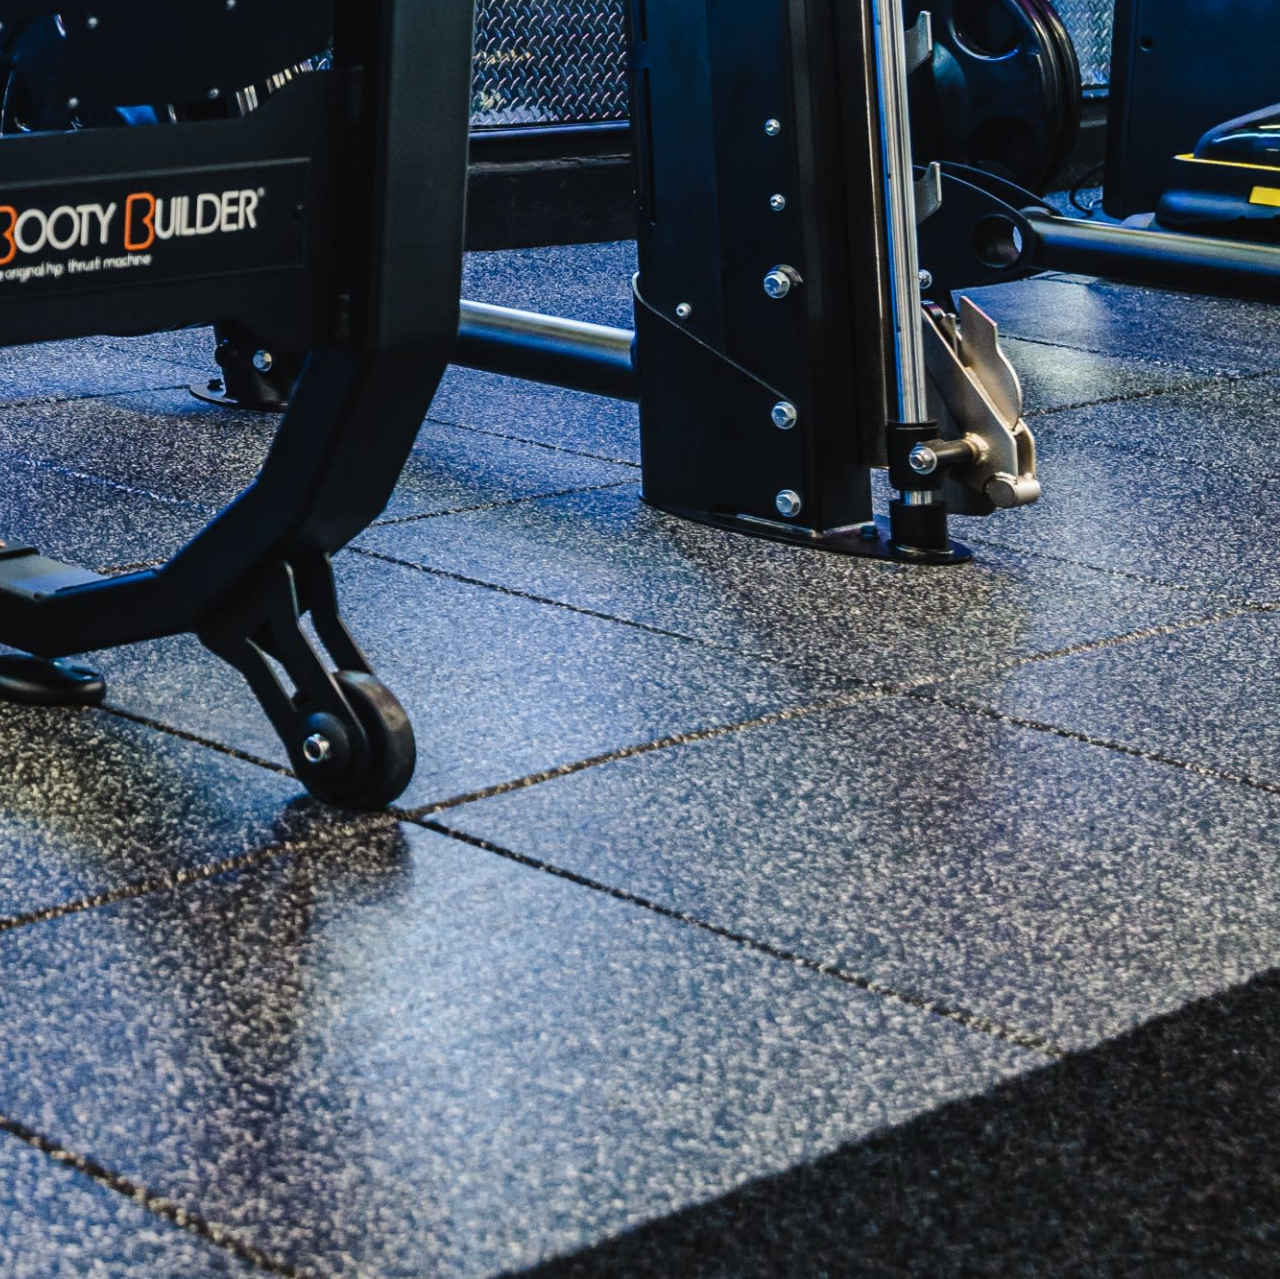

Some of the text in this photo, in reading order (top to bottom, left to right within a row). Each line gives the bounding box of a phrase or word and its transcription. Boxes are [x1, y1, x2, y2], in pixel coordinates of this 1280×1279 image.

[5, 263, 44, 283] original
[46, 261, 64, 278] hip
[68, 256, 101, 273] thrust
[103, 252, 152, 269] machine
